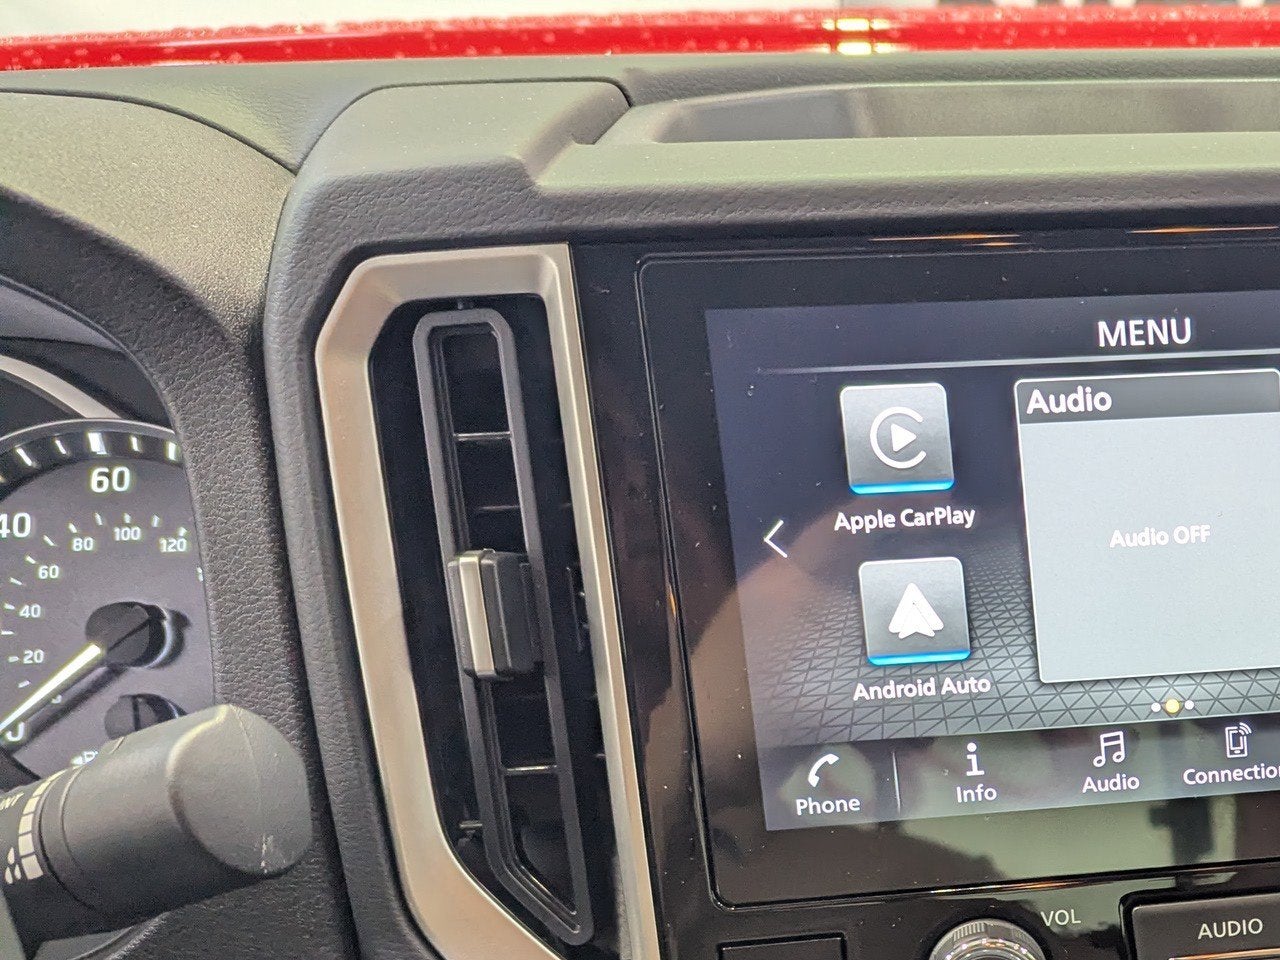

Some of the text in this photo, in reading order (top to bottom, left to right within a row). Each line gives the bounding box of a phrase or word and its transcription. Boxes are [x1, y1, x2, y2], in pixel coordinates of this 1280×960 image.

[1097, 316, 1193, 347] MENU
[1025, 386, 1113, 415] Audio
[90, 466, 131, 493] 60
[834, 506, 976, 534] Apple CarPlay
[114, 526, 142, 541] 100
[1109, 524, 1211, 548] Audio OFF
[72, 537, 94, 552] 80
[159, 537, 188, 553] 120
[38, 564, 60, 579] 60
[19, 604, 42, 619] 40
[23, 648, 45, 664] 20
[852, 676, 991, 702] Android Auto
[1081, 770, 1141, 794] Audio
[956, 783, 998, 804] Info
[795, 796, 861, 816] Phone
[1040, 908, 1082, 927] VOL
[1197, 918, 1263, 941] AUDIO
